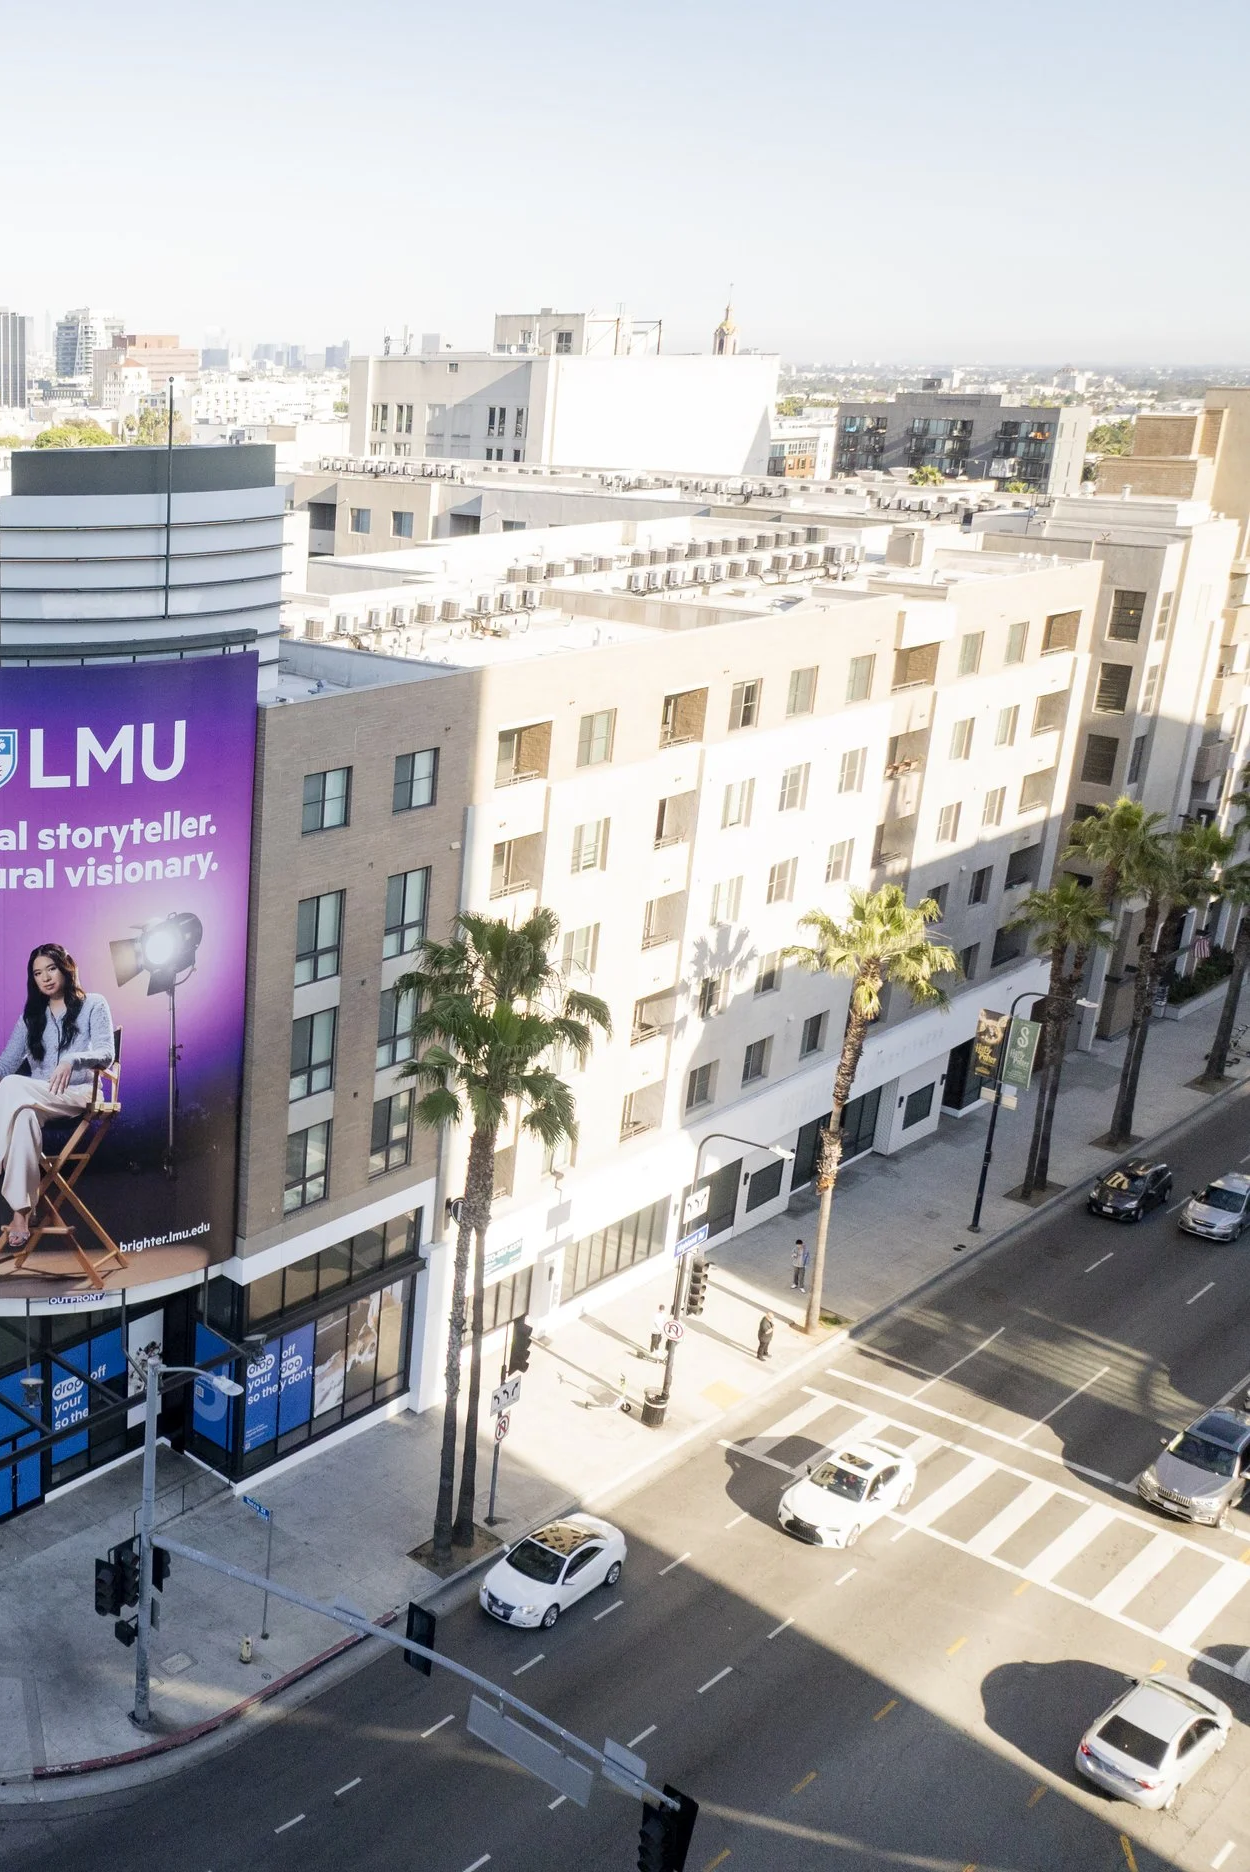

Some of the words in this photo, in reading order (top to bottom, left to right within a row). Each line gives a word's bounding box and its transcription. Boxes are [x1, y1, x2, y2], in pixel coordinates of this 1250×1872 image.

[29, 719, 187, 788] LMU
[37, 810, 217, 853] storyteller.
[65, 850, 219, 888] visionary.
[975, 1043, 993, 1056] Harry
[119, 1222, 210, 1253] brighter.lmu.edu
[50, 1293, 104, 1305] OUTFRONT
[282, 1343, 296, 1359] off
[54, 1380, 84, 1397] drop
[90, 1364, 107, 1380] off
[247, 1372, 272, 1393] your
[247, 1394, 260, 1405] so
[288, 1365, 313, 1385] don't
[54, 1394, 83, 1418] your
[54, 1419, 69, 1431] so
